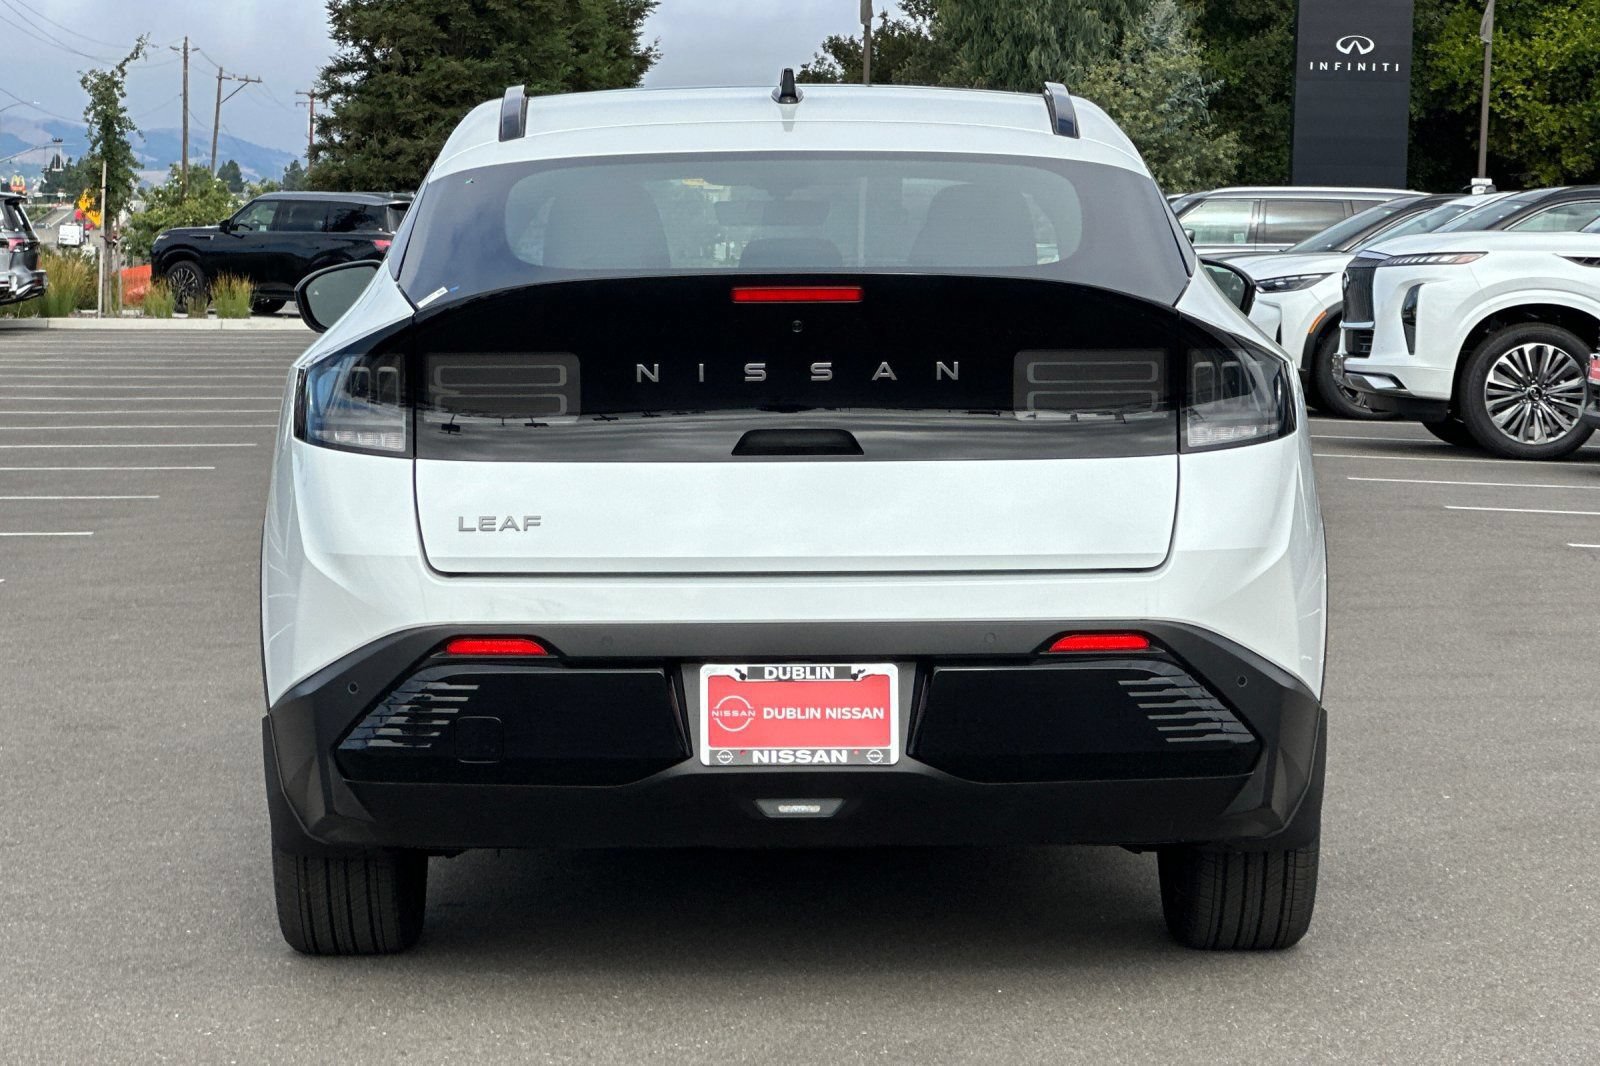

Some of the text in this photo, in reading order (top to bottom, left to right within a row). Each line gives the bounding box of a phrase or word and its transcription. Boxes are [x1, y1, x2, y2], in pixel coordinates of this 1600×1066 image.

[1309, 61, 1399, 72] INFINITI
[636, 361, 959, 383] NISSAN
[458, 515, 542, 532] LEAF
[764, 666, 835, 680] DUBLIN
[711, 709, 756, 717] NISSAN
[763, 706, 885, 720] DUBLIN NISSAN
[752, 749, 848, 764] NISSAN
